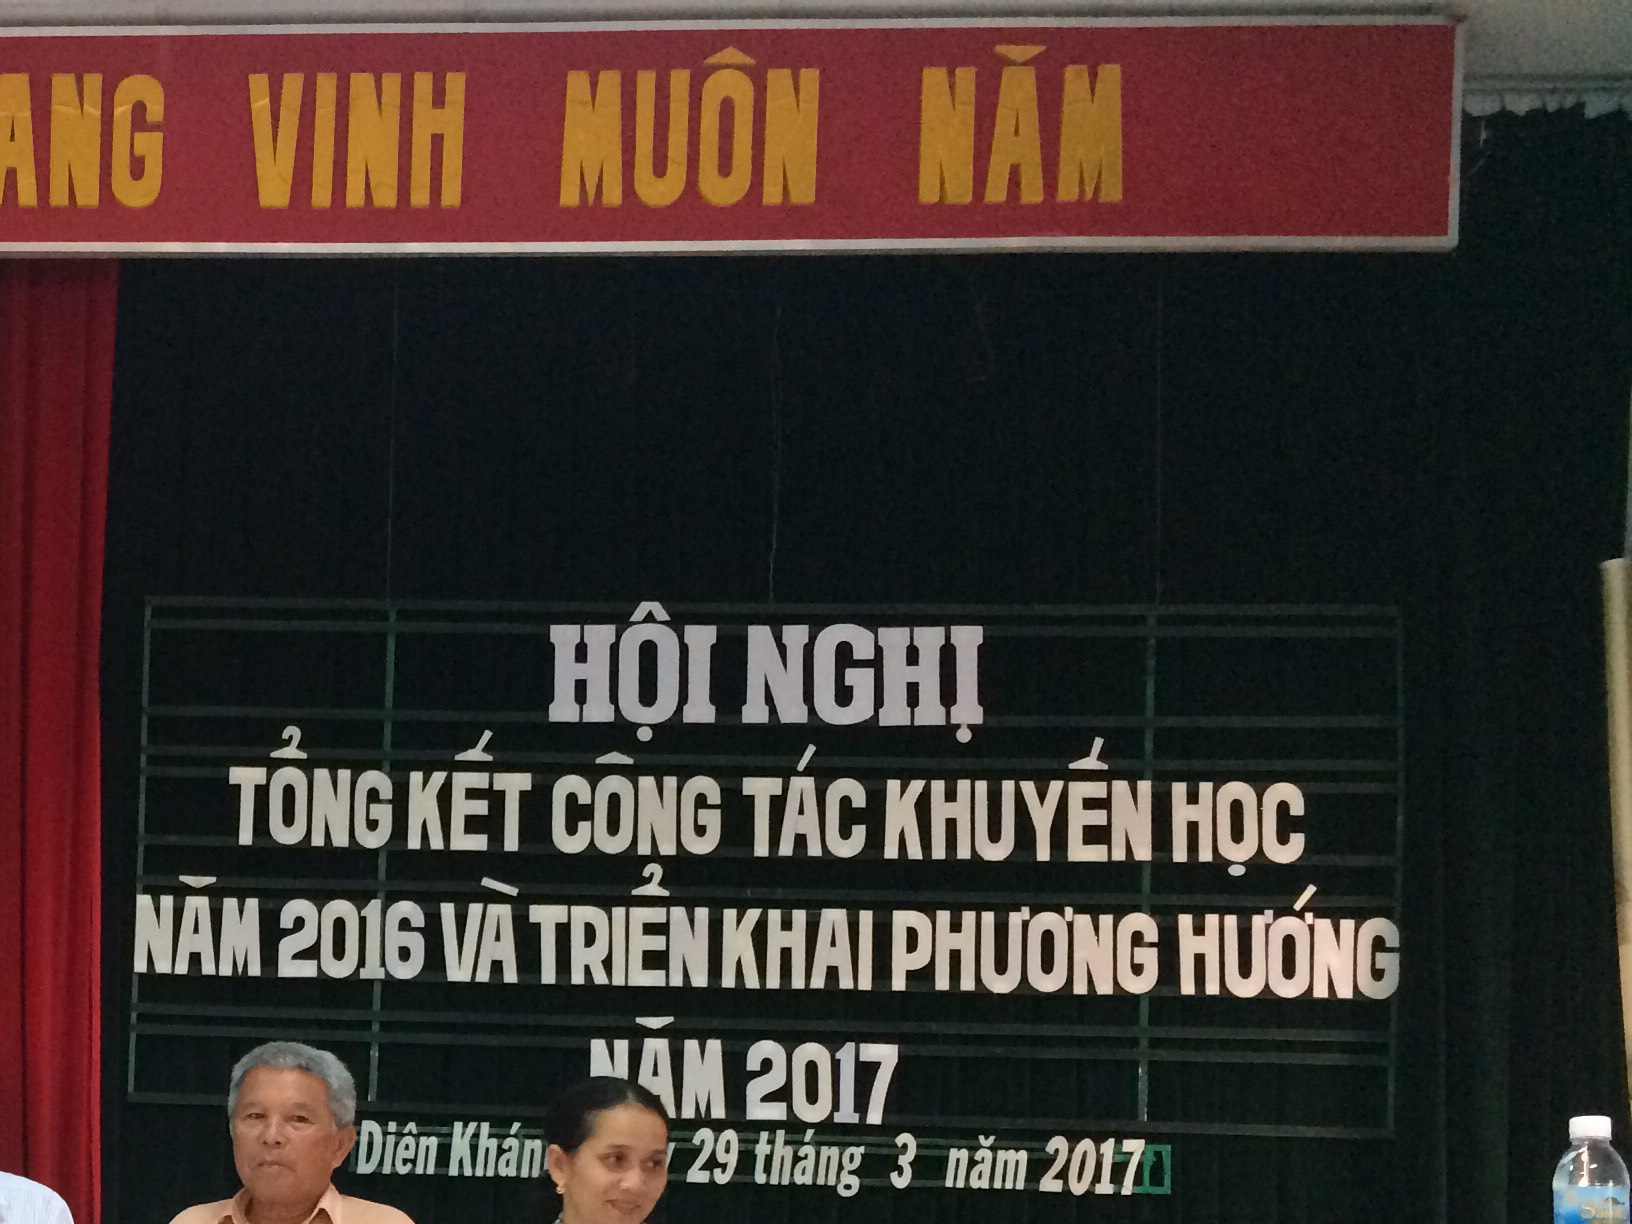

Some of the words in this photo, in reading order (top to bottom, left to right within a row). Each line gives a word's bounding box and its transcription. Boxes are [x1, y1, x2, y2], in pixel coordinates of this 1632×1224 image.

[249, 72, 464, 208] VINH
[560, 49, 818, 206] MUÔN
[919, 46, 1121, 204] NĂM
[549, 602, 716, 741] HỘI
[742, 624, 983, 743] NGHỊ
[229, 726, 392, 848] TỔNG
[408, 730, 531, 851] KẾT
[552, 752, 721, 855] CÔNG
[743, 744, 866, 858] TÁC
[884, 737, 1152, 862] KHUYẾN
[1172, 781, 1305, 876] HỌC
[134, 876, 261, 976] NĂM
[278, 899, 424, 979] 2016
[440, 878, 518, 983] VÀ
[529, 863, 709, 987] TRIỂN
[725, 908, 873, 991] KHAI
[892, 907, 1158, 995] PHƯƠNG
[1178, 884, 1399, 999] HƯỚNG
[746, 1040, 898, 1124] 2017
[356, 1120, 438, 1175] Diên
[449, 1122, 546, 1178] Khán
[687, 1128, 738, 1184] 29
[755, 1129, 864, 1196] tháng
[890, 1133, 916, 1188] 3
[945, 1135, 1027, 1189] năm
[1039, 1136, 1145, 1196] 2017
